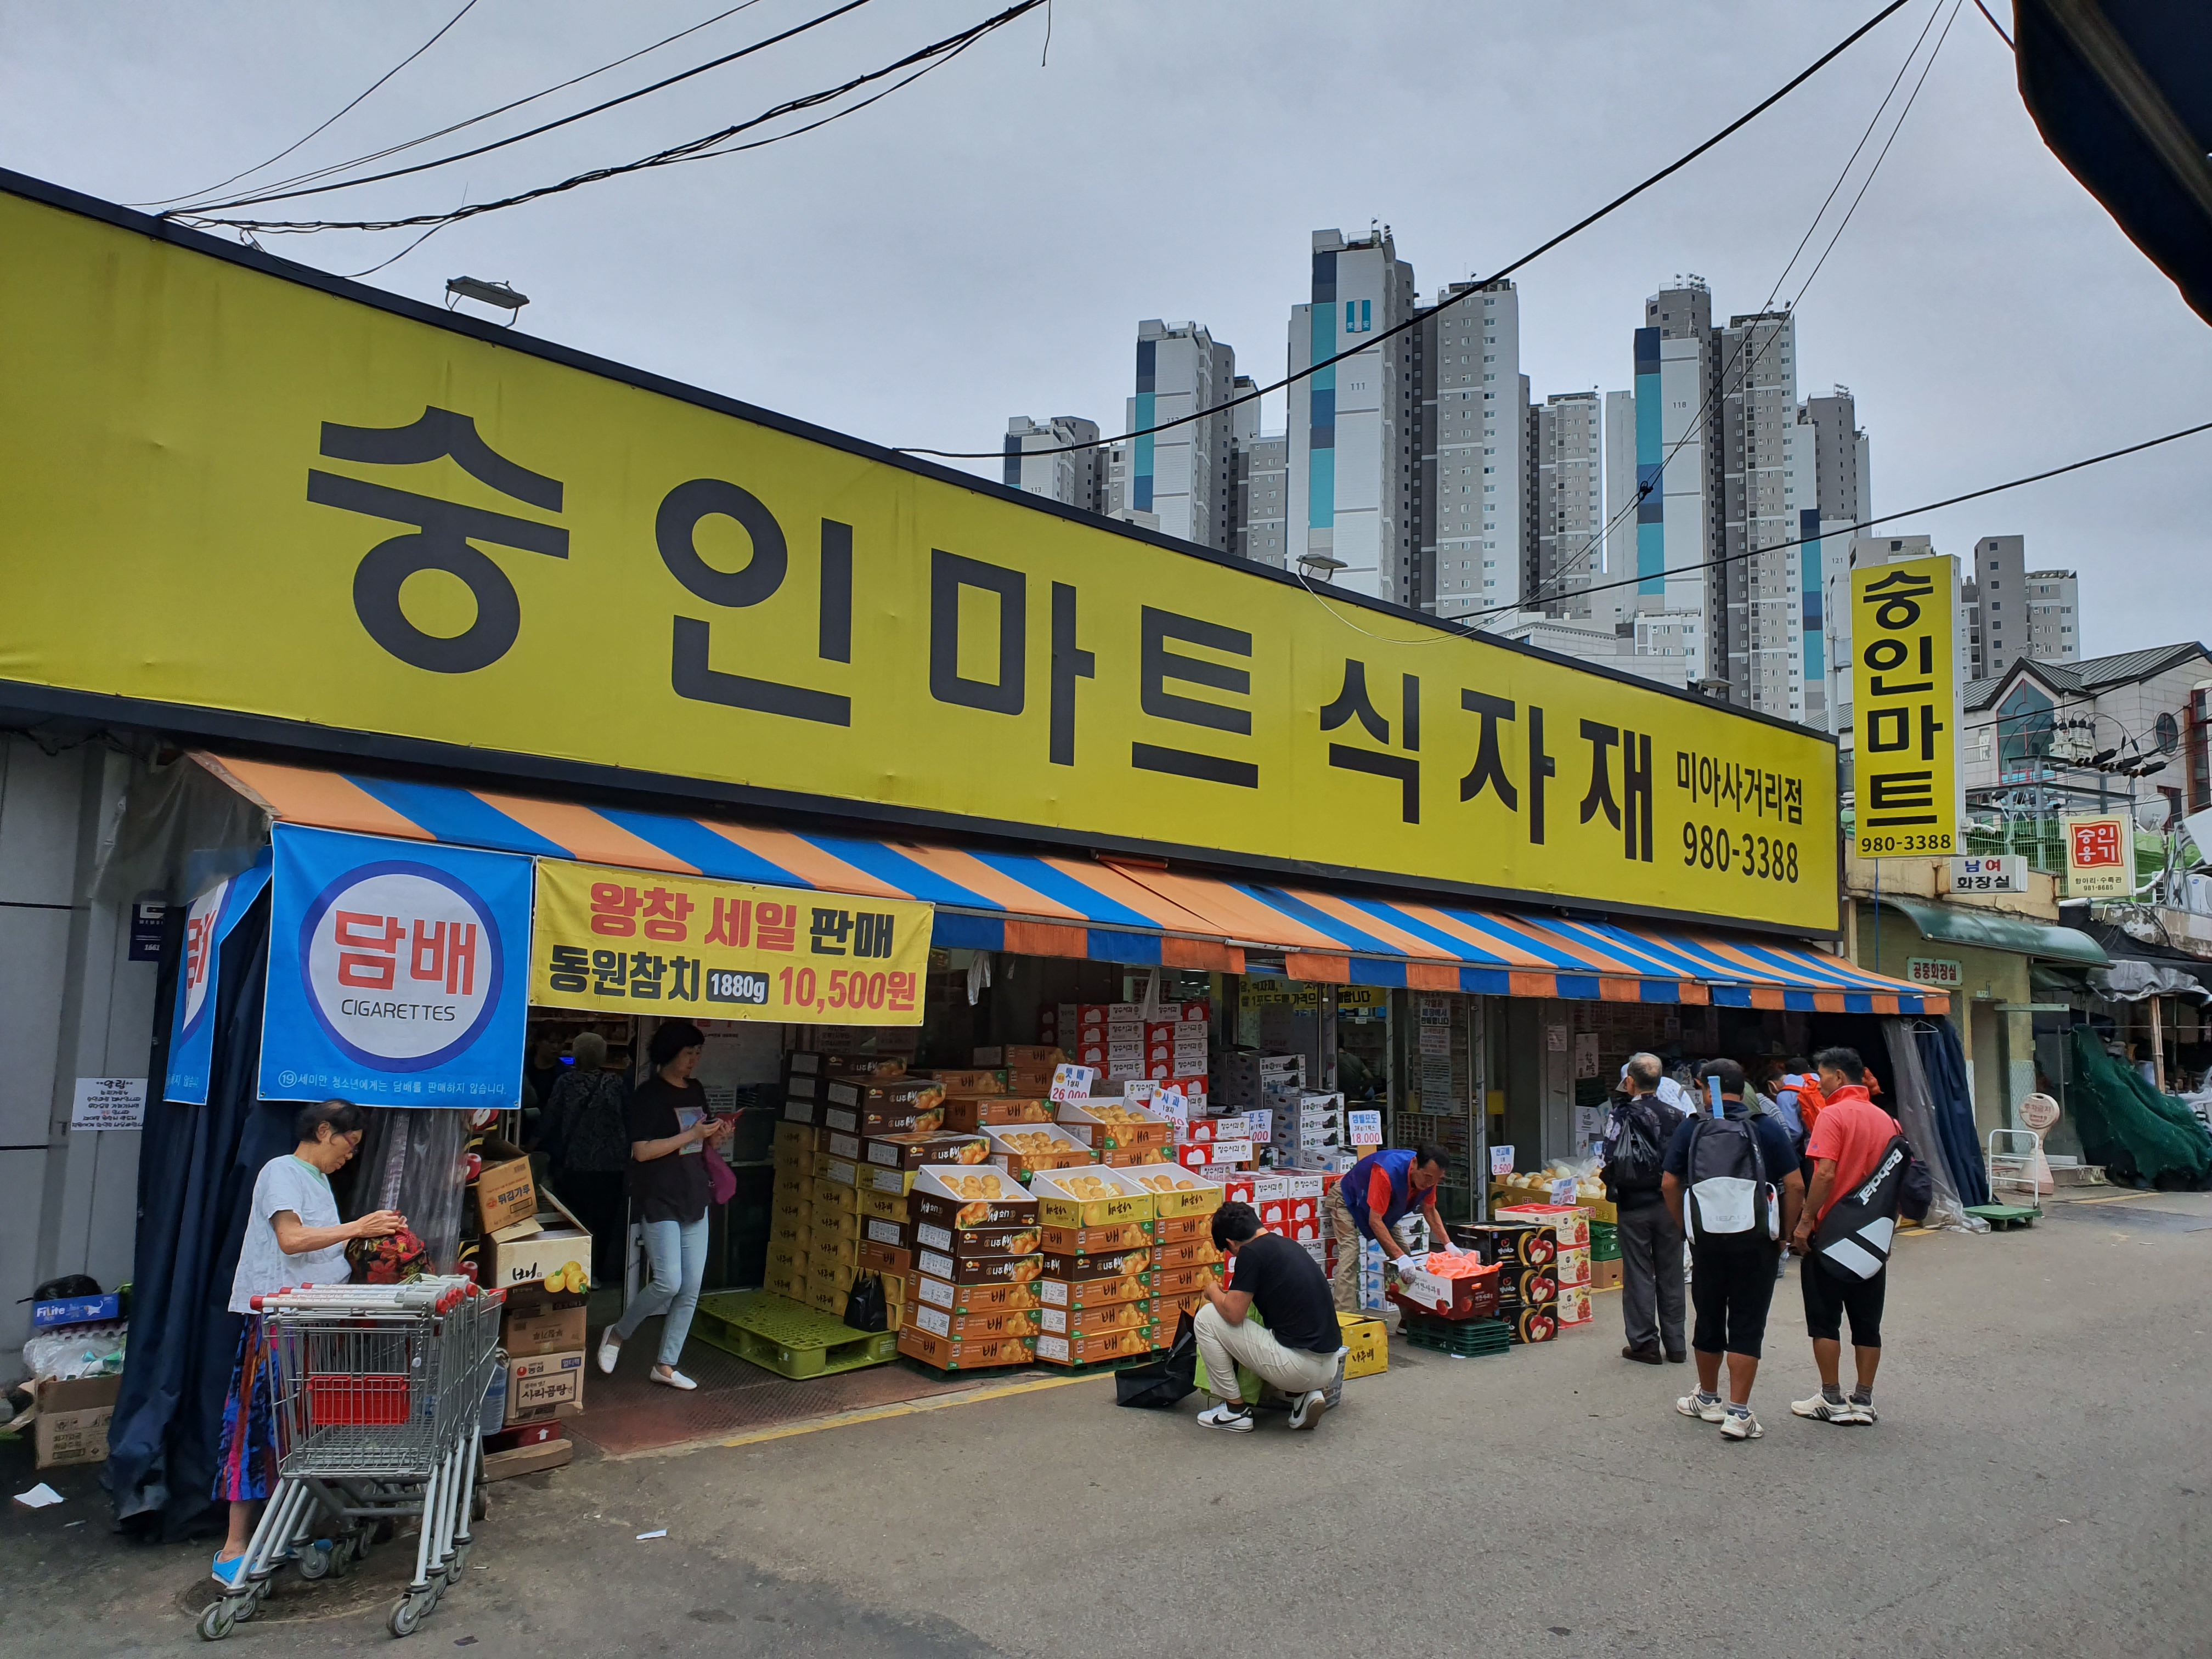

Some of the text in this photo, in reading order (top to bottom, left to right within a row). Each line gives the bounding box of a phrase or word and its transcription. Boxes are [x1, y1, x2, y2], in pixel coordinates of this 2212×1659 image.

[1351, 382, 1365, 391] 111
[1673, 400, 1687, 409] 118
[307, 405, 1653, 864] 숭인마트 식자재
[1863, 569, 1944, 827] 숭인마트
[1677, 751, 1802, 825] 미아사거리점
[1861, 833, 1951, 853] 980-3388
[1683, 821, 1798, 884] 980-3388
[2077, 844, 2116, 864] 용기
[1964, 858, 2001, 873] 남 여
[1956, 874, 2011, 890] 화장실
[589, 882, 895, 959] 왕창 세일 판매
[335, 910, 476, 995] 담배
[549, 944, 917, 1014] 동원참치 1880g 10,500원
[1912, 961, 1957, 982] 공중화장실
[1292, 992, 1324, 1005] 가격으
[341, 999, 456, 1022] CIGARETTES
[332, 1076, 388, 1092] 청소년에게는
[393, 1081, 422, 1093] 담배를
[428, 1082, 465, 1094] 판매하지
[1007, 1103, 1021, 1117] 배
[1221, 1122, 1239, 1130] 장수사과
[1217, 1145, 1240, 1154] 장수사과
[1130, 1152, 1143, 1165] 배
[1860, 1148, 1904, 1206] Babolat
[1259, 1183, 1277, 1192] 장수사과
[1183, 1218, 1196, 1233] 배
[1105, 1228, 1120, 1243] 배
[1180, 1245, 1194, 1260] 배
[1179, 1271, 1192, 1285] 배
[991, 1288, 1006, 1304] 배
[1103, 1281, 1117, 1296] 배
[36, 1306, 66, 1317] FiLite
[1101, 1308, 1115, 1323] 배
[988, 1316, 1003, 1331] 배
[983, 1342, 998, 1357] 배
[1104, 1335, 1118, 1351] 배
[1352, 1347, 1375, 1363] 나주배
[528, 1365, 544, 1374] 농심
